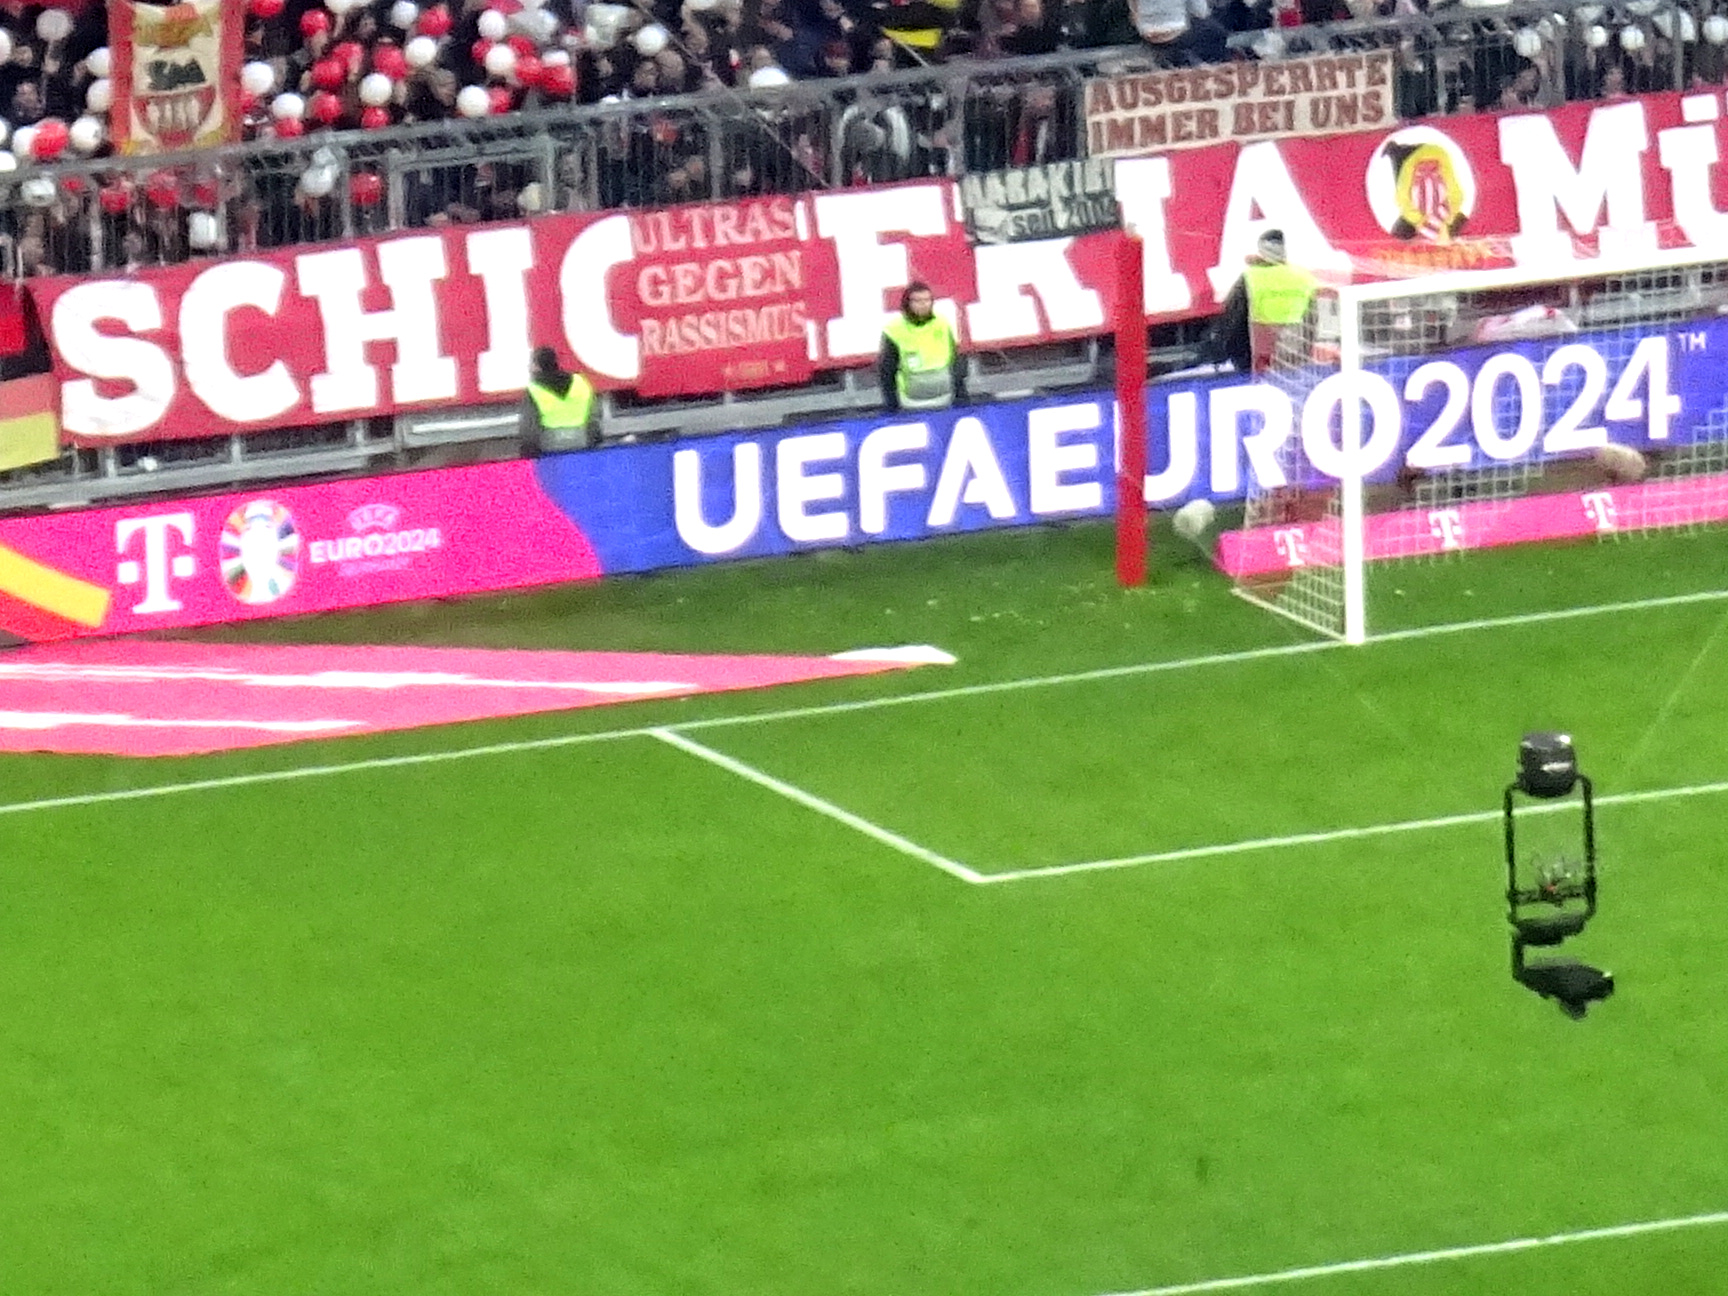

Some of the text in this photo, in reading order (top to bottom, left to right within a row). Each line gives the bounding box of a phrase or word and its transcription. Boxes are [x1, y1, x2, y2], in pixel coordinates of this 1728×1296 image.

[1089, 54, 1388, 114] AUSGESPERRTE
[1092, 89, 1384, 155] IMMER BEI UNS
[631, 197, 795, 254] ULTRAS
[52, 140, 1352, 437] SCHICERIA
[636, 250, 802, 306] GEGEN
[640, 301, 806, 355] RASSISMUS
